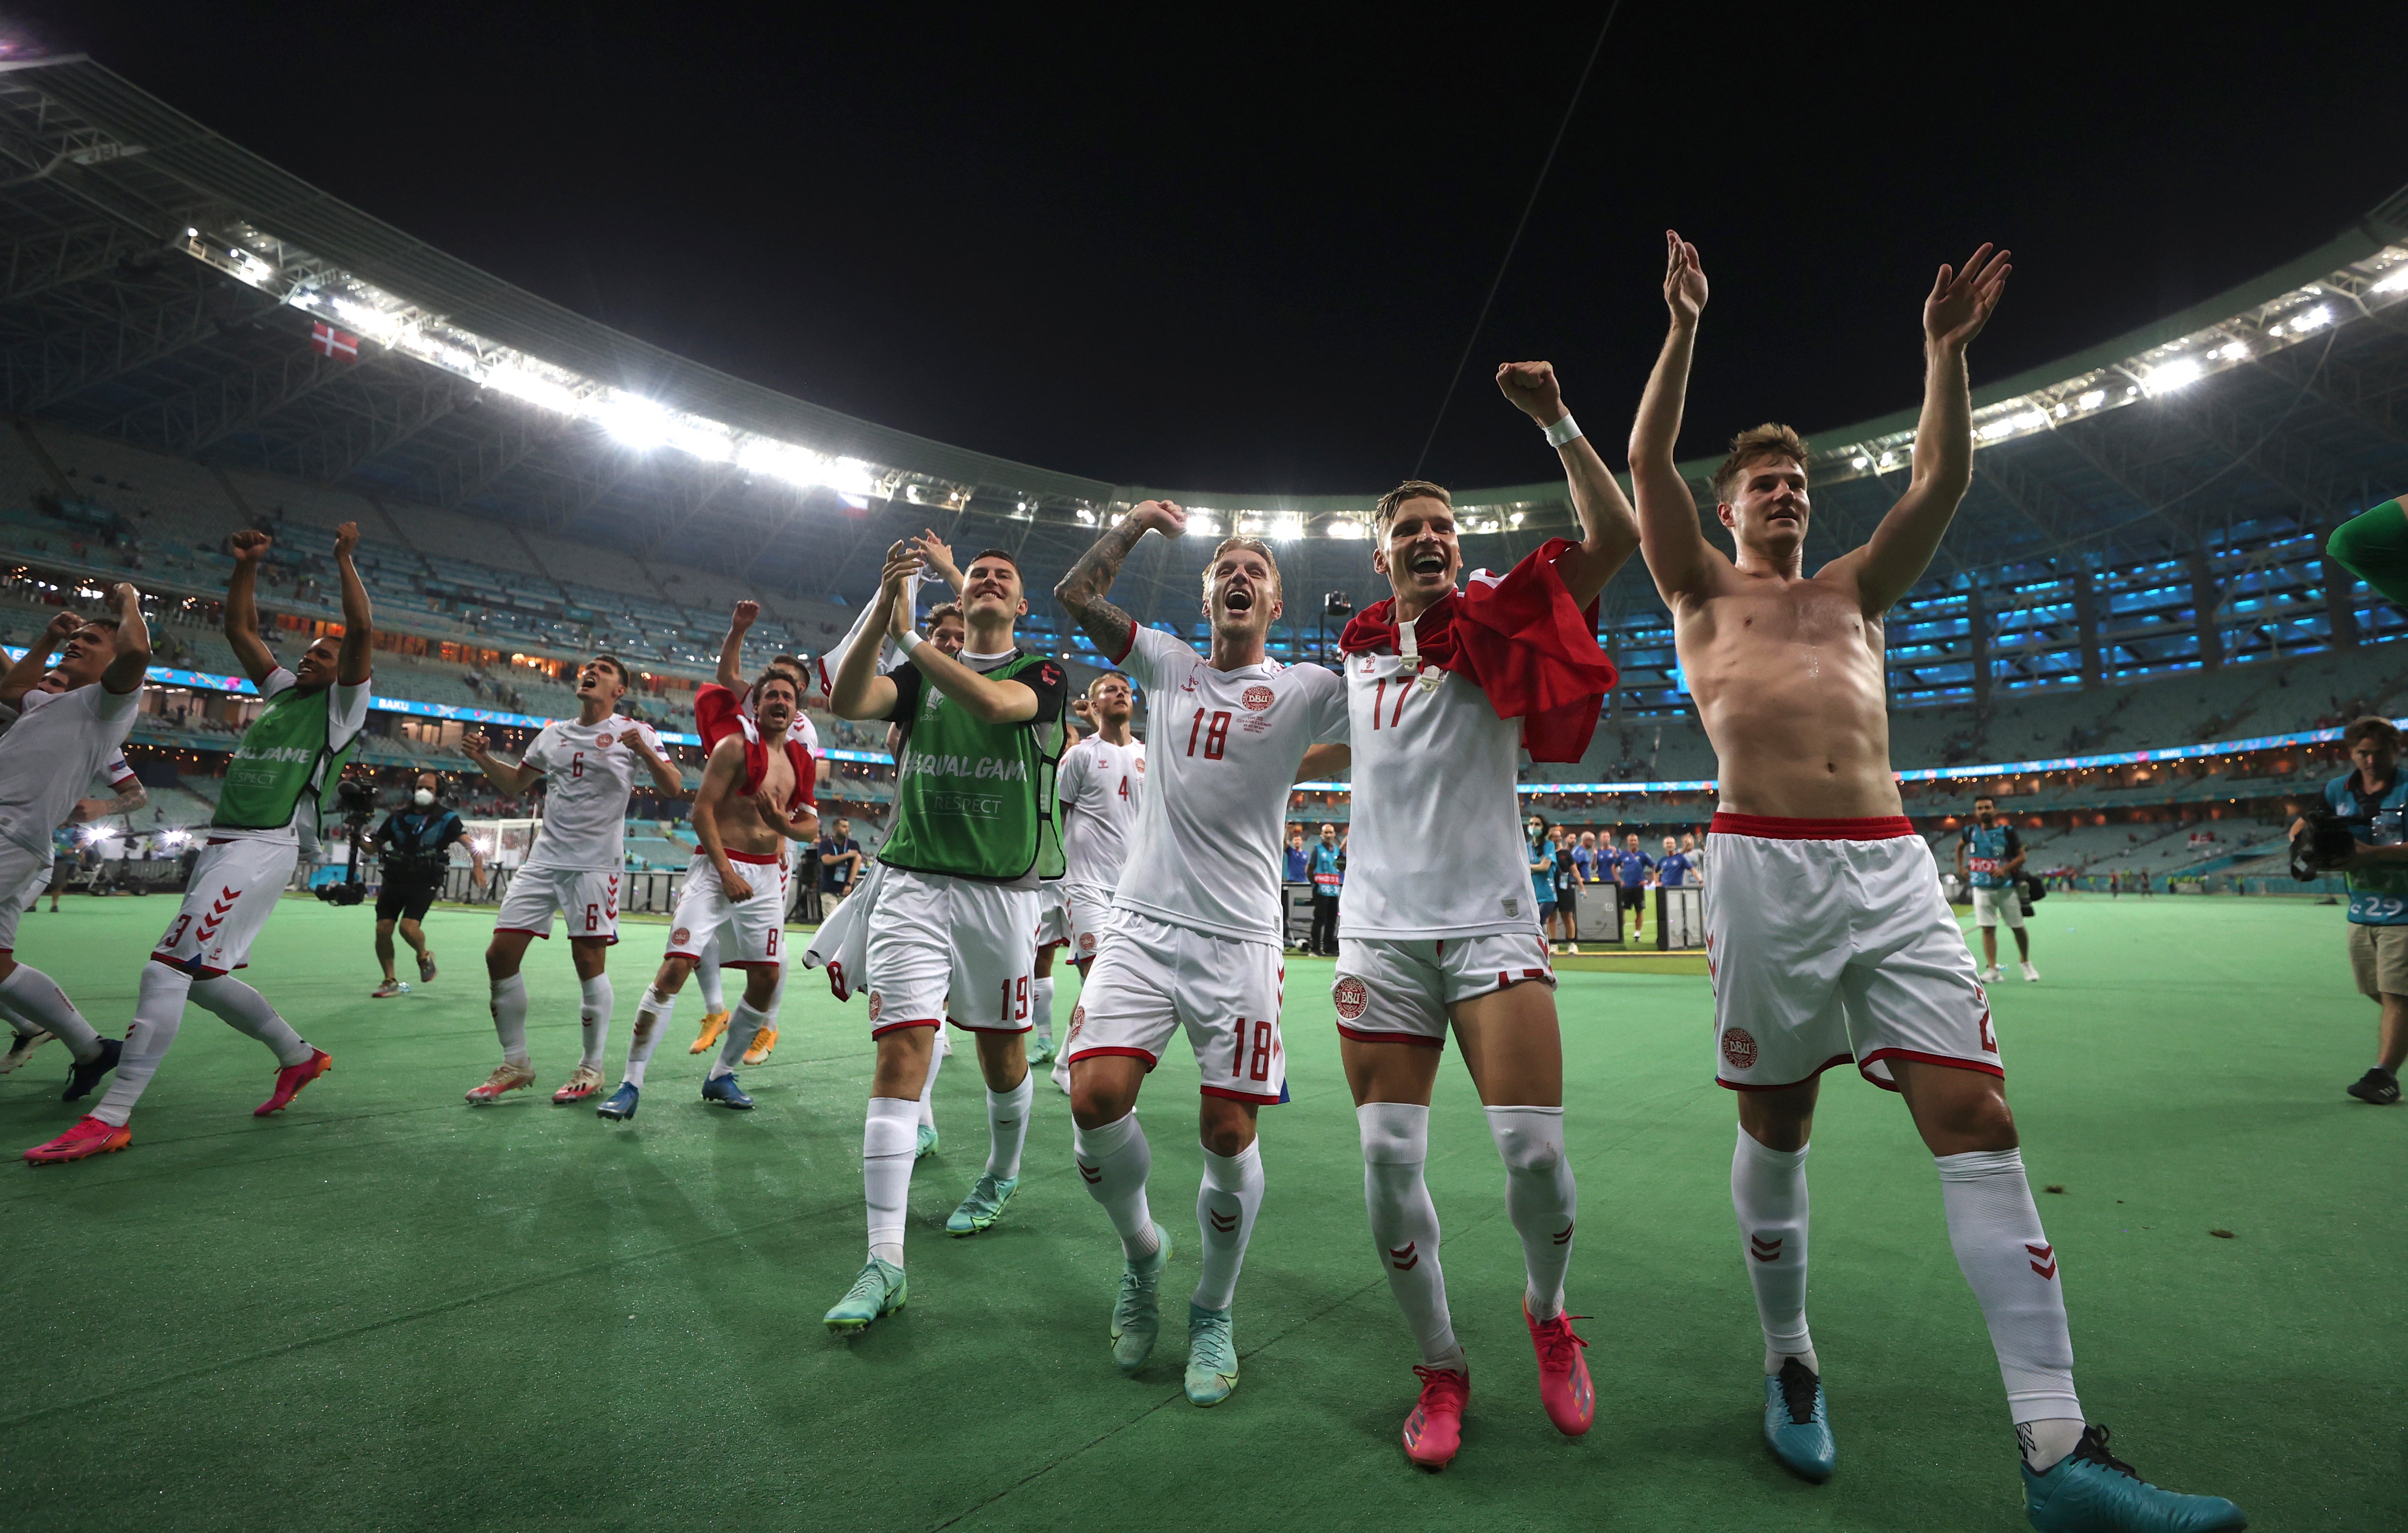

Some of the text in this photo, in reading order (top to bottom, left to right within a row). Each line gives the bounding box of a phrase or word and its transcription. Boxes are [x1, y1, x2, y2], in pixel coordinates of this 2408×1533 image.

[378, 698, 409, 711] BAKU
[1248, 695, 1268, 703] DBU
[1374, 675, 1416, 730] 17
[1187, 708, 1232, 760] 18
[573, 752, 584, 777] 6
[834, 750, 855, 761] BAKU
[2159, 749, 2182, 759] BAKU
[1118, 776, 1128, 801] 4
[934, 796, 1002, 814] RESPECT
[586, 904, 598, 931] 6
[2365, 897, 2403, 916] 29
[166, 914, 192, 948] 3
[766, 928, 778, 956] 8
[1001, 976, 1028, 1020] 19
[1341, 991, 1361, 1004] DBU
[1357, 992, 1367, 1014] UNION
[1974, 984, 1998, 1055] 2
[1233, 1018, 1272, 1082] 18
[1729, 1041, 1751, 1054] DBU
